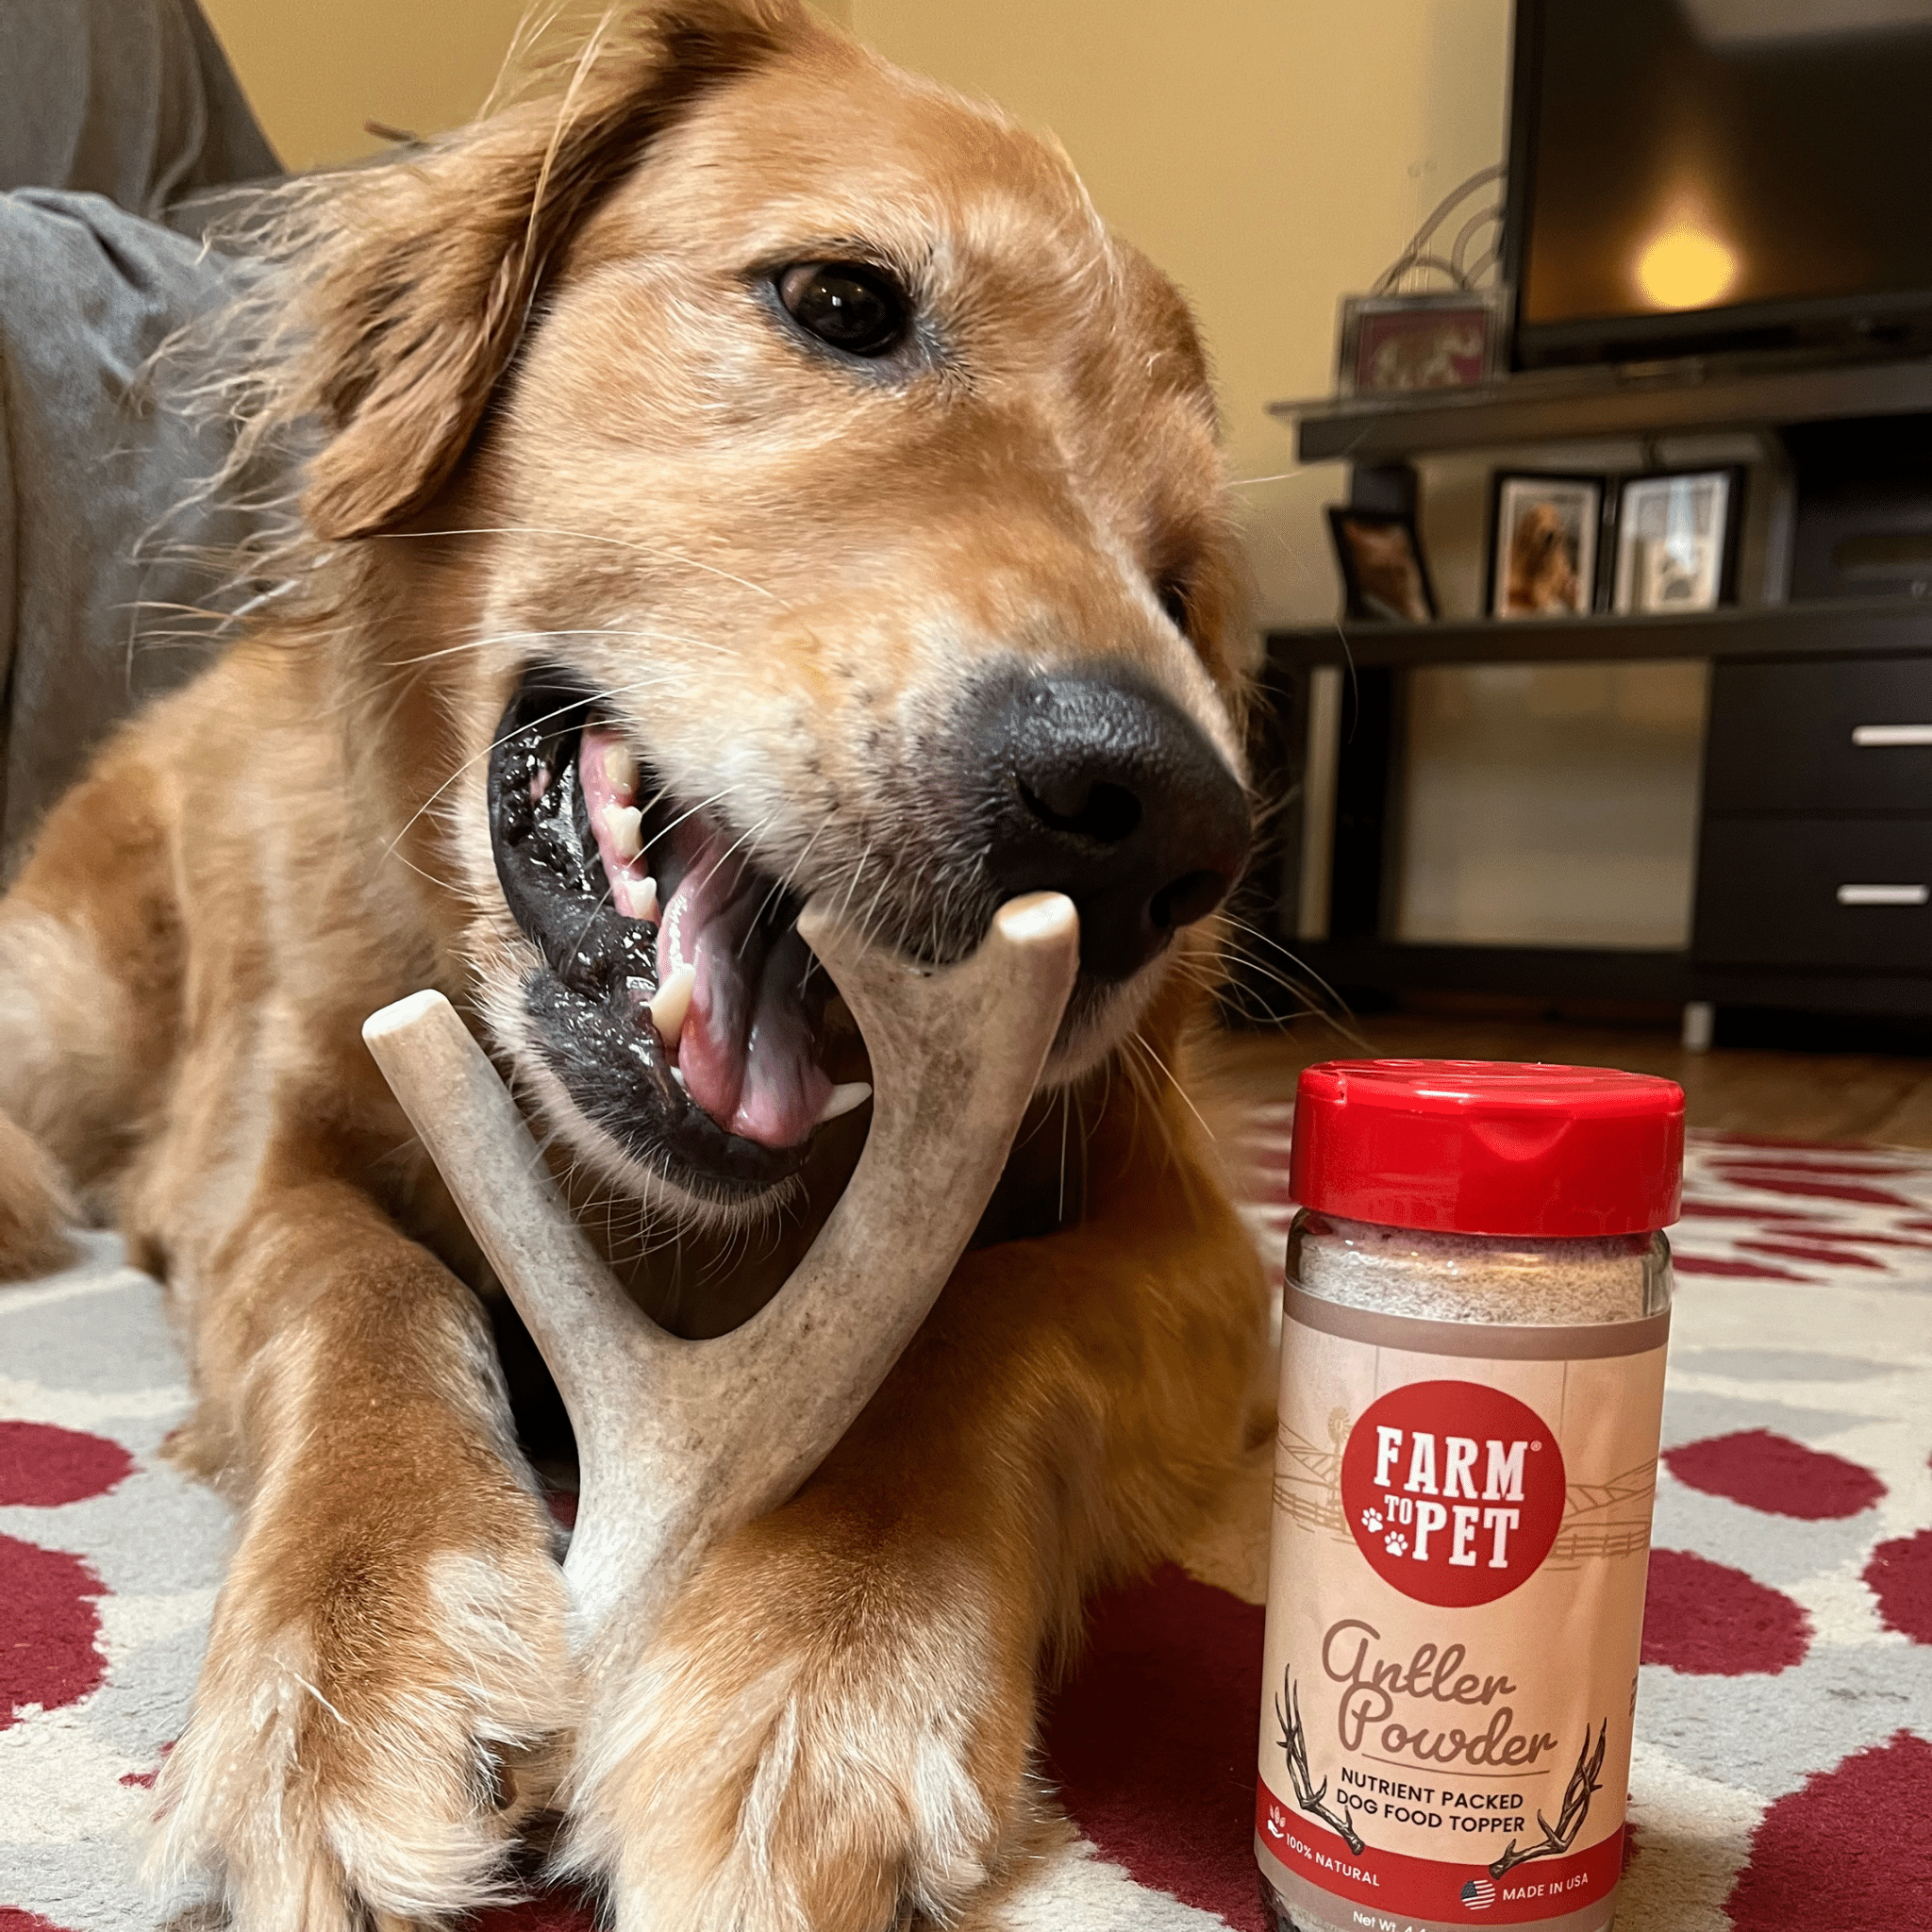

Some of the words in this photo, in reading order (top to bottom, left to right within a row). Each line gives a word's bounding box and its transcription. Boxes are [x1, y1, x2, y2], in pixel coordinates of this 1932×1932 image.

[1384, 1494, 1412, 1524] TO
[1412, 1500, 1520, 1568] PET
[1322, 1619, 1517, 1706] Antler
[1338, 1681, 1558, 1766] Powder
[1341, 1767, 1435, 1804] NUTRIENT
[1441, 1791, 1524, 1809] PACKED
[1337, 1789, 1378, 1814] DOG
[1384, 1804, 1442, 1828] FOOD
[1449, 1815, 1525, 1833] TOPPER
[1286, 1832, 1312, 1859] 100%
[1315, 1852, 1380, 1887] NATURAL
[1503, 1884, 1545, 1901] MADE
[1549, 1882, 1563, 1895] IN
[1566, 1873, 1589, 1890] USA
[1353, 1910, 1375, 1928] Net
[1378, 1918, 1399, 1932] Wt
